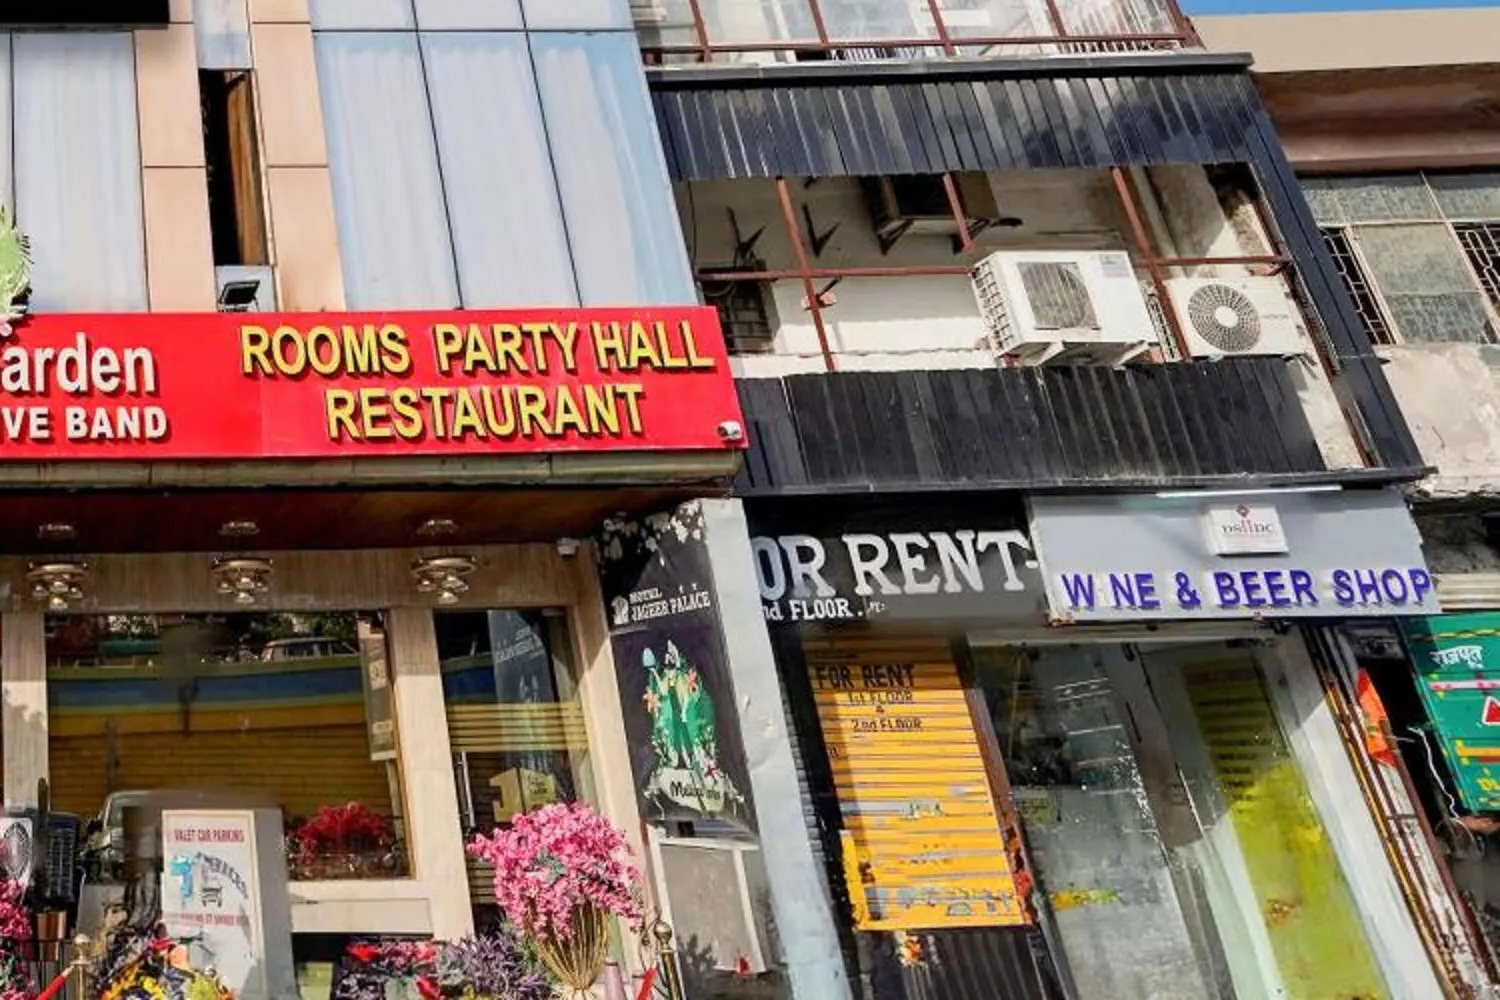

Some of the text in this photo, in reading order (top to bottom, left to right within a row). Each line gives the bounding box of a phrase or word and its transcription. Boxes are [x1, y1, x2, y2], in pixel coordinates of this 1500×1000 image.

[240, 319, 715, 376] ROOMS PARTY HALL
[65, 406, 169, 439] BAND
[325, 383, 644, 440] RESTAURANT
[670, 590, 712, 616] PALACE
[1060, 566, 1432, 610] WNE & BEER SHOP
[814, 663, 915, 689] FOR RENT
